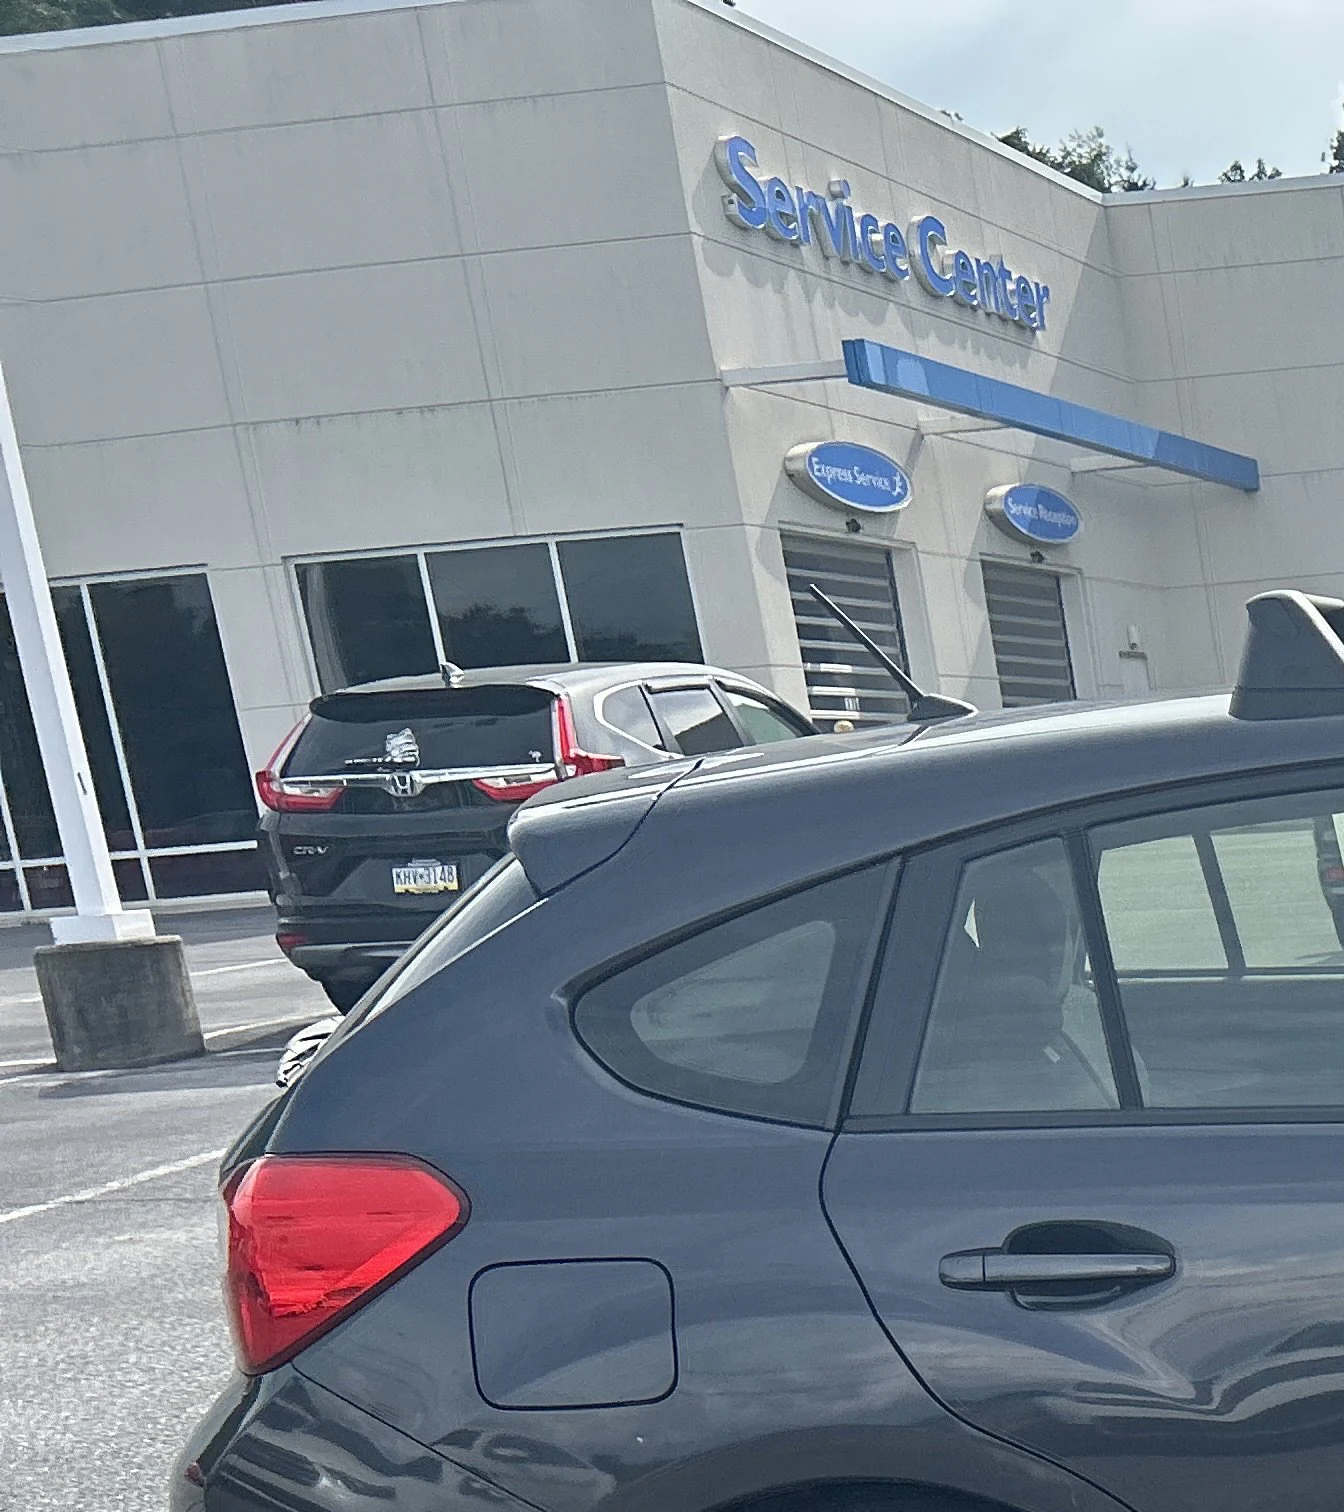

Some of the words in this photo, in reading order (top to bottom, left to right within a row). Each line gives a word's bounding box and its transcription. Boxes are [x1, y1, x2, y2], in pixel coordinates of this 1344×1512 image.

[714, 135, 910, 282] Service
[906, 214, 1050, 332] Center
[811, 457, 853, 484] Express
[853, 466, 893, 493] Service
[1008, 497, 1038, 520] Service
